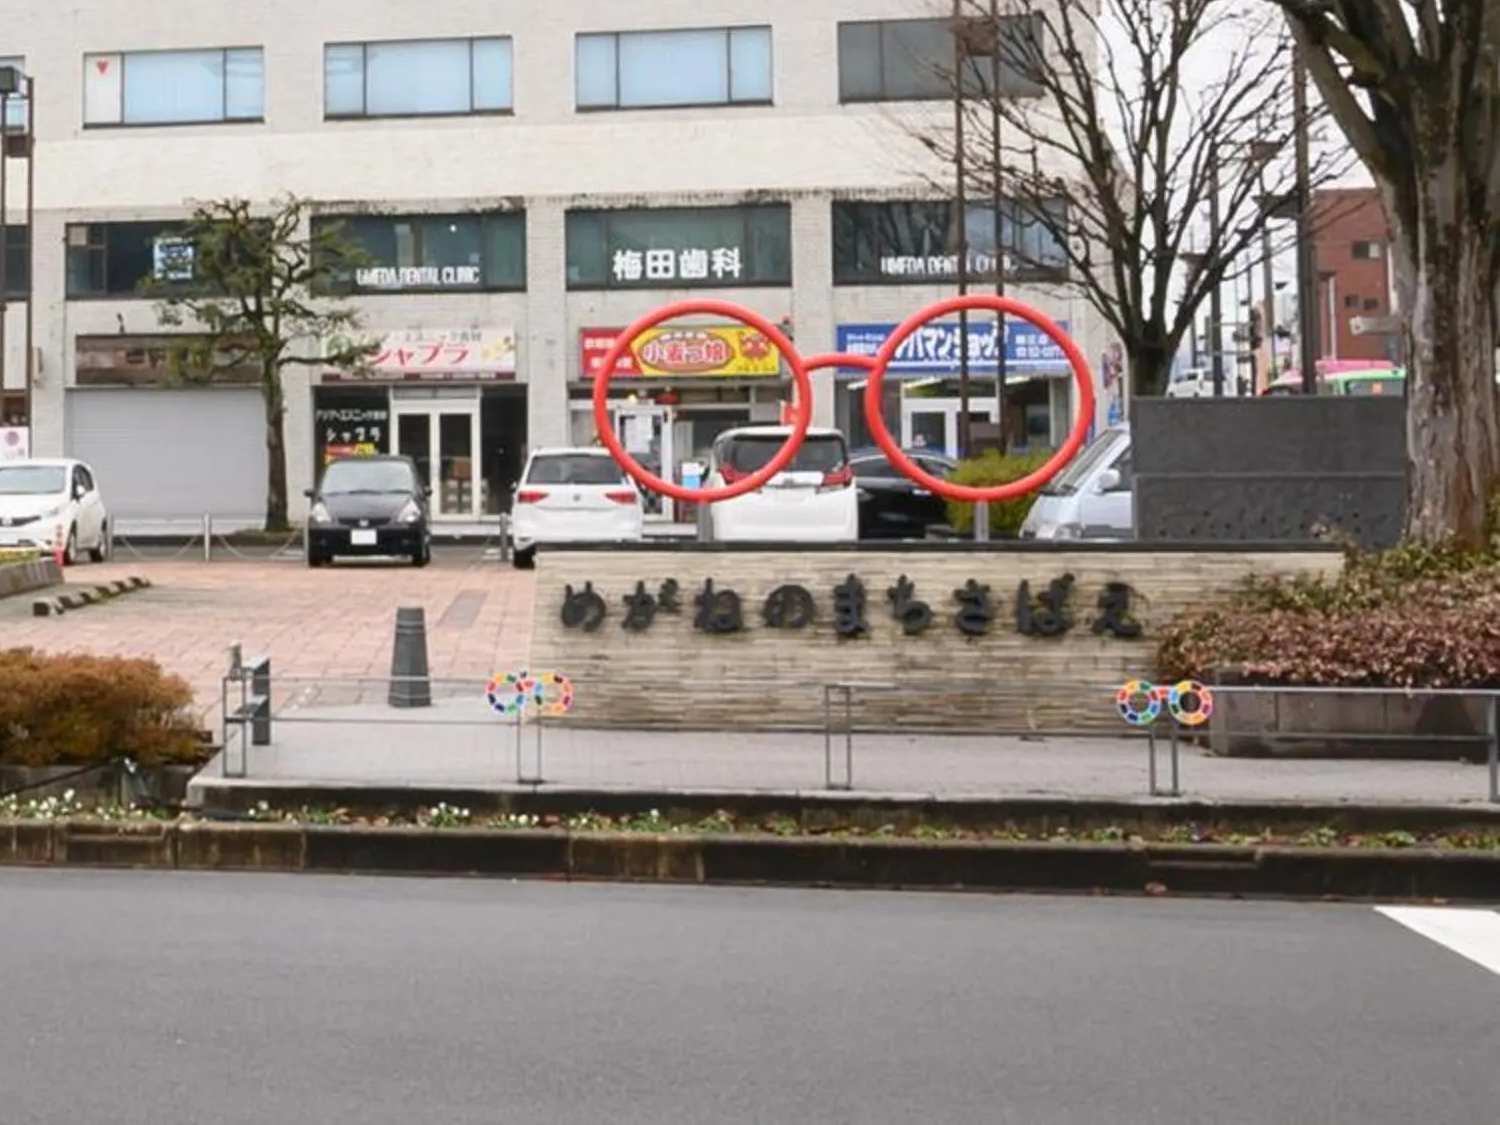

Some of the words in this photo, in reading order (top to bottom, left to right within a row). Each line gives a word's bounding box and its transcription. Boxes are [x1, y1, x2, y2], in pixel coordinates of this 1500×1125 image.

[612, 247, 742, 280] 梅田歯科
[927, 253, 972, 274] DENTL
[560, 573, 1144, 639] めがねのまちさばえ
